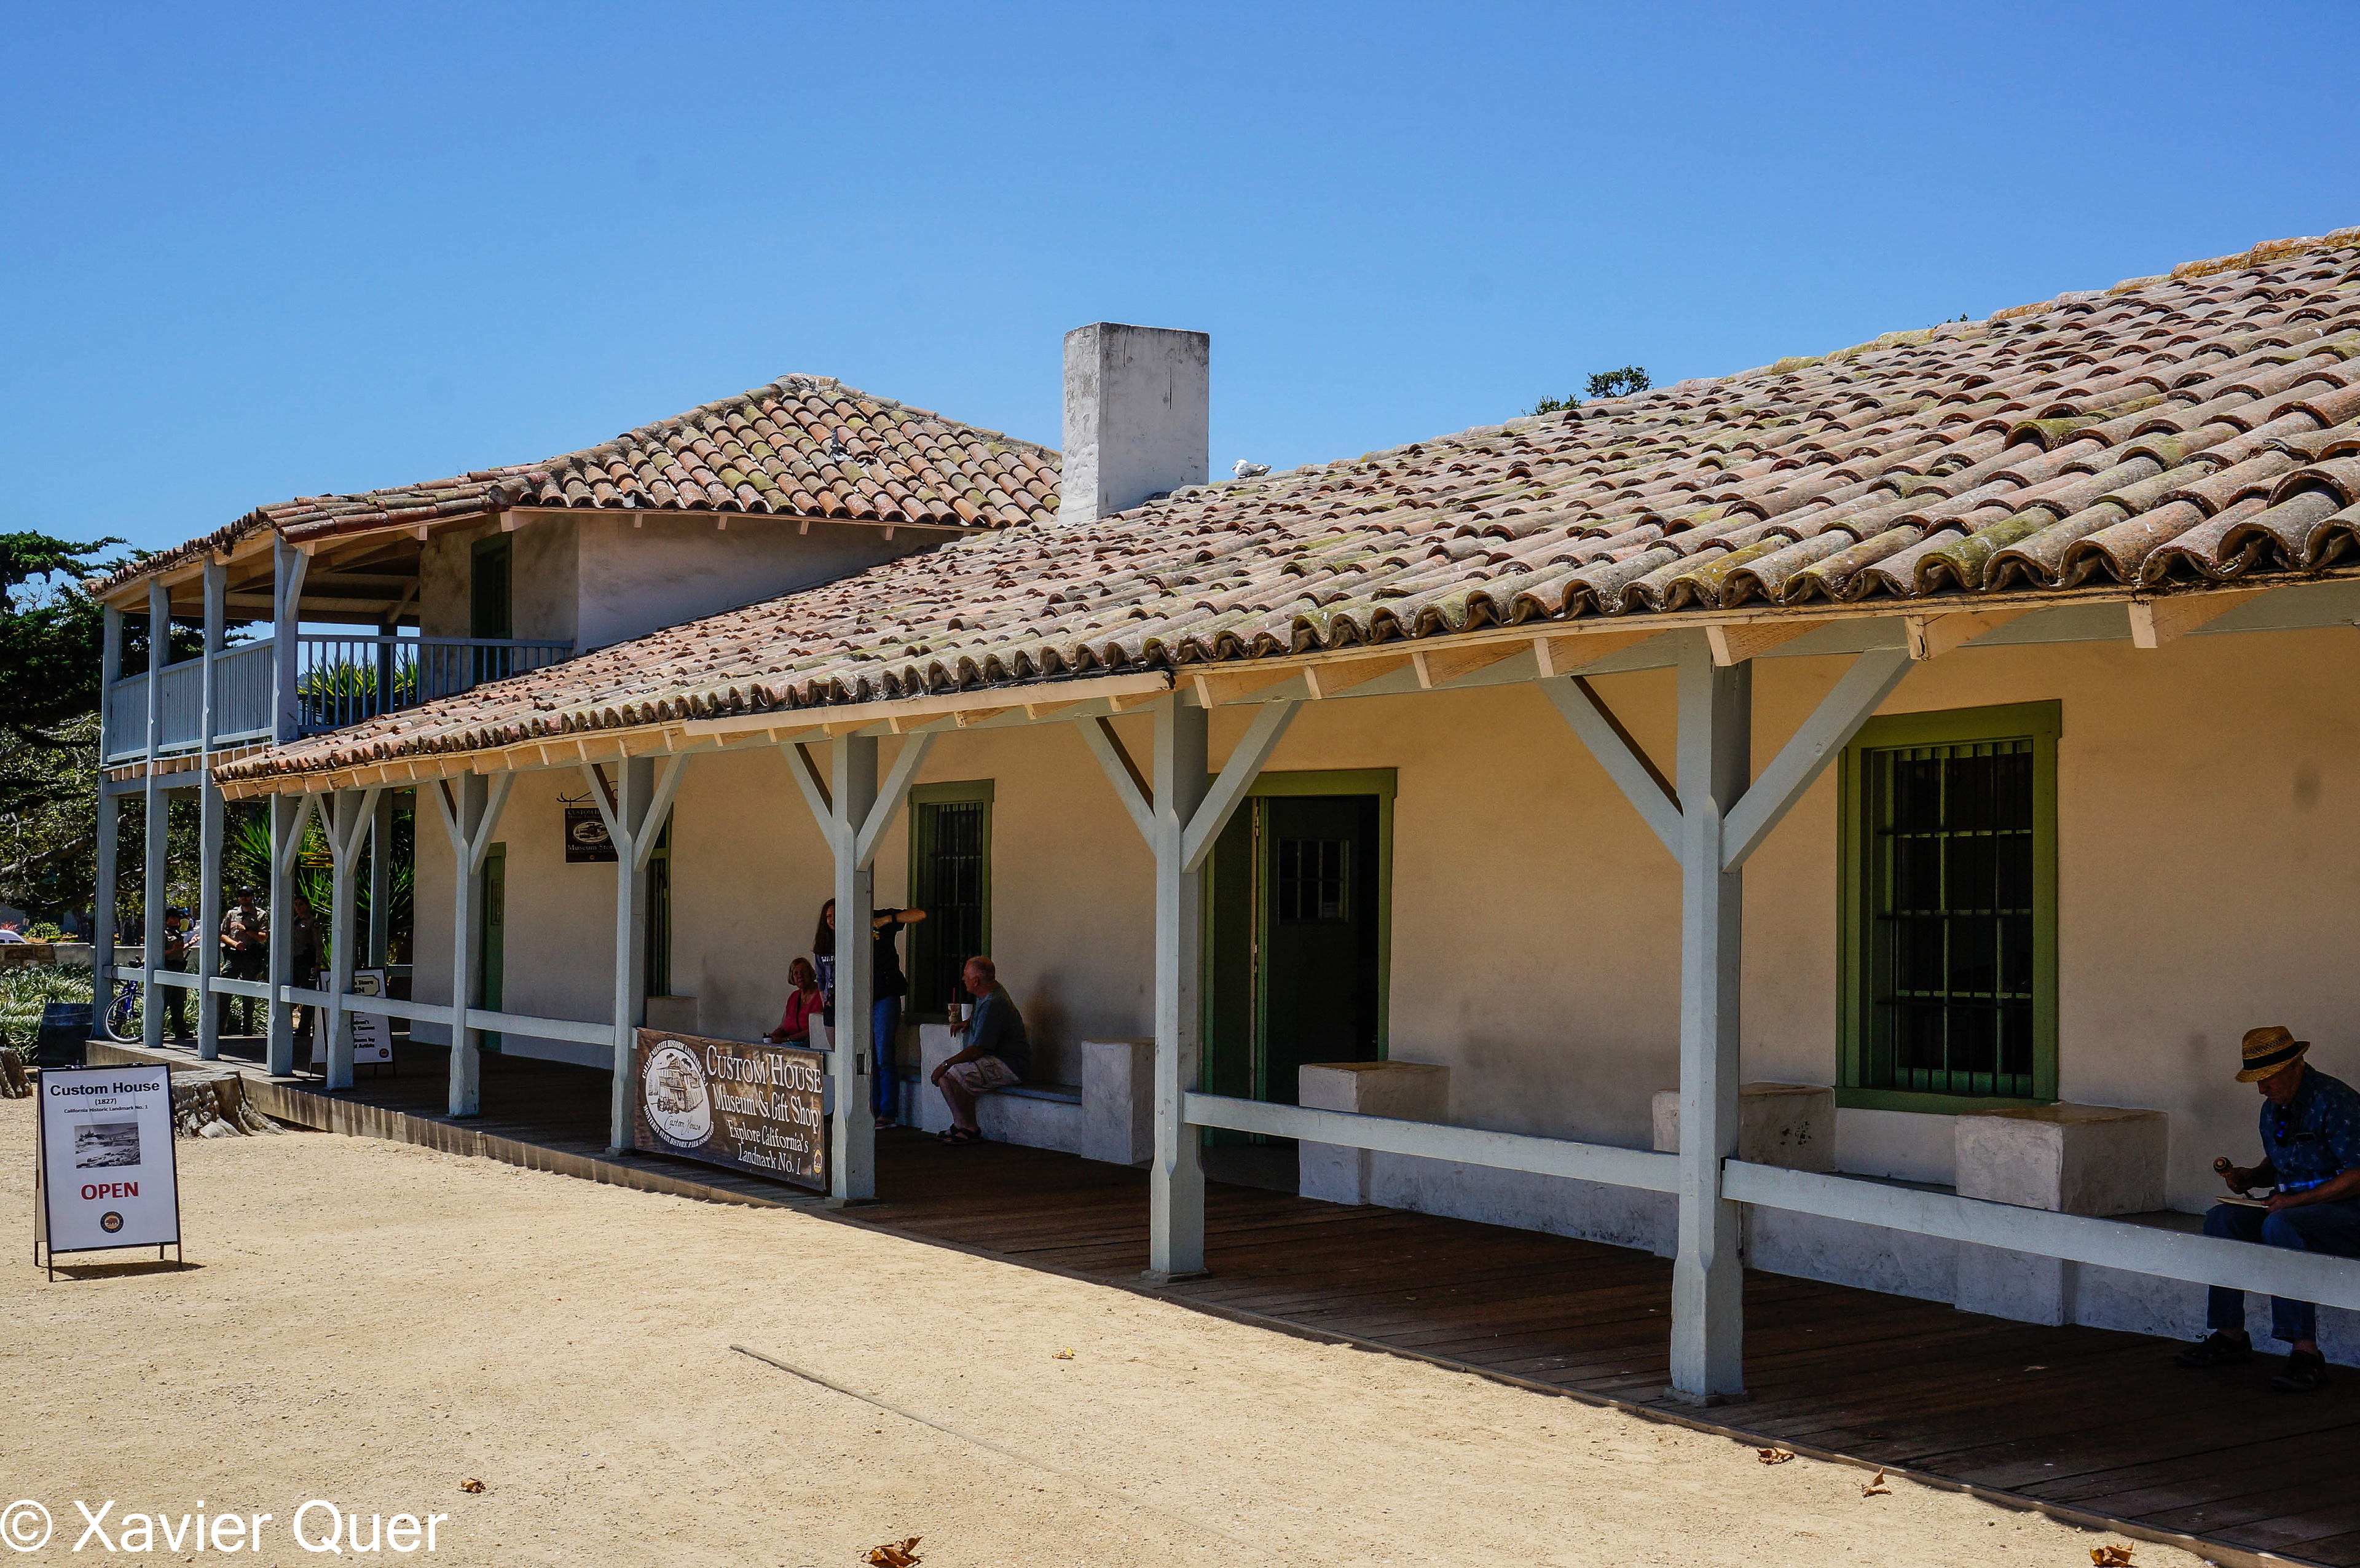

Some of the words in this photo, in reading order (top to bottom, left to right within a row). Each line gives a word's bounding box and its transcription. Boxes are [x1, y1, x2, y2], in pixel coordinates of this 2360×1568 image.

[706, 1045, 766, 1084] CUSTOM
[768, 1053, 823, 1094] HOUSE
[50, 1084, 108, 1096] Custom
[112, 1082, 160, 1094] House
[643, 1105, 659, 1133] MONTEREY
[658, 1130, 671, 1143] STATE
[712, 1084, 757, 1116] Museum
[758, 1090, 770, 1118] &
[771, 1092, 790, 1123] Gift
[790, 1096, 819, 1134] Shop
[726, 1119, 760, 1145] Explore
[761, 1125, 809, 1153] California's
[738, 1143, 776, 1169] Landmark
[778, 1151, 795, 1173] No.
[796, 1158, 801, 1175] 1
[81, 1182, 139, 1200] OPEN
